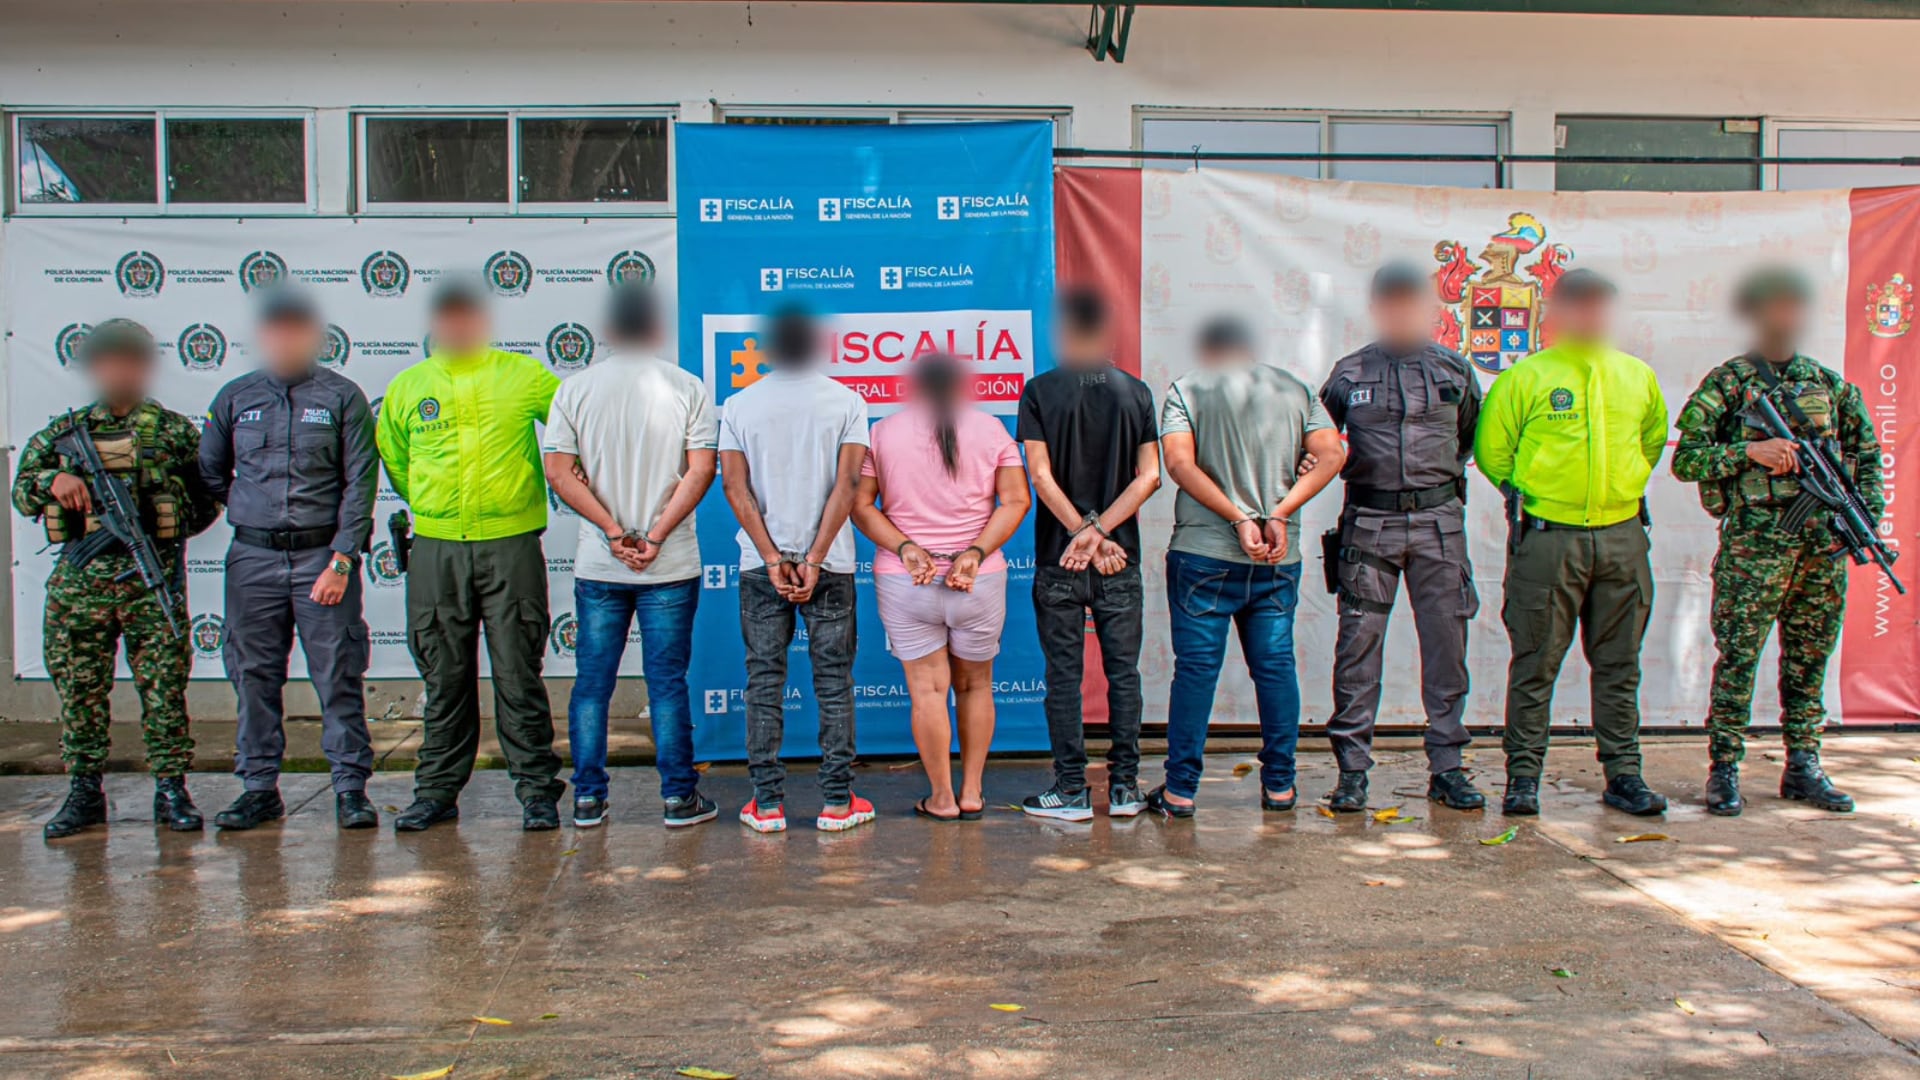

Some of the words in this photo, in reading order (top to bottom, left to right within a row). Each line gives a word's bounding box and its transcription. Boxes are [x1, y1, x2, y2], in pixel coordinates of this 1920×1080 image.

[725, 196, 794, 210] FISCALÍA
[843, 195, 912, 209] FISCALÍA
[962, 192, 1029, 208] FISCALÍA
[785, 265, 854, 279] FISCALÍA
[905, 263, 973, 277] FISCALÍA
[829, 320, 1022, 364] ISCALÍA
[975, 376, 1019, 395] CIÓN
[1351, 389, 1372, 402] CTI
[239, 411, 262, 422] CTI
[304, 408, 330, 417] POLICÍA
[301, 415, 331, 425] JUDICIAL
[853, 685, 909, 697] FISCAL
[991, 677, 1046, 693] SCALÍA
